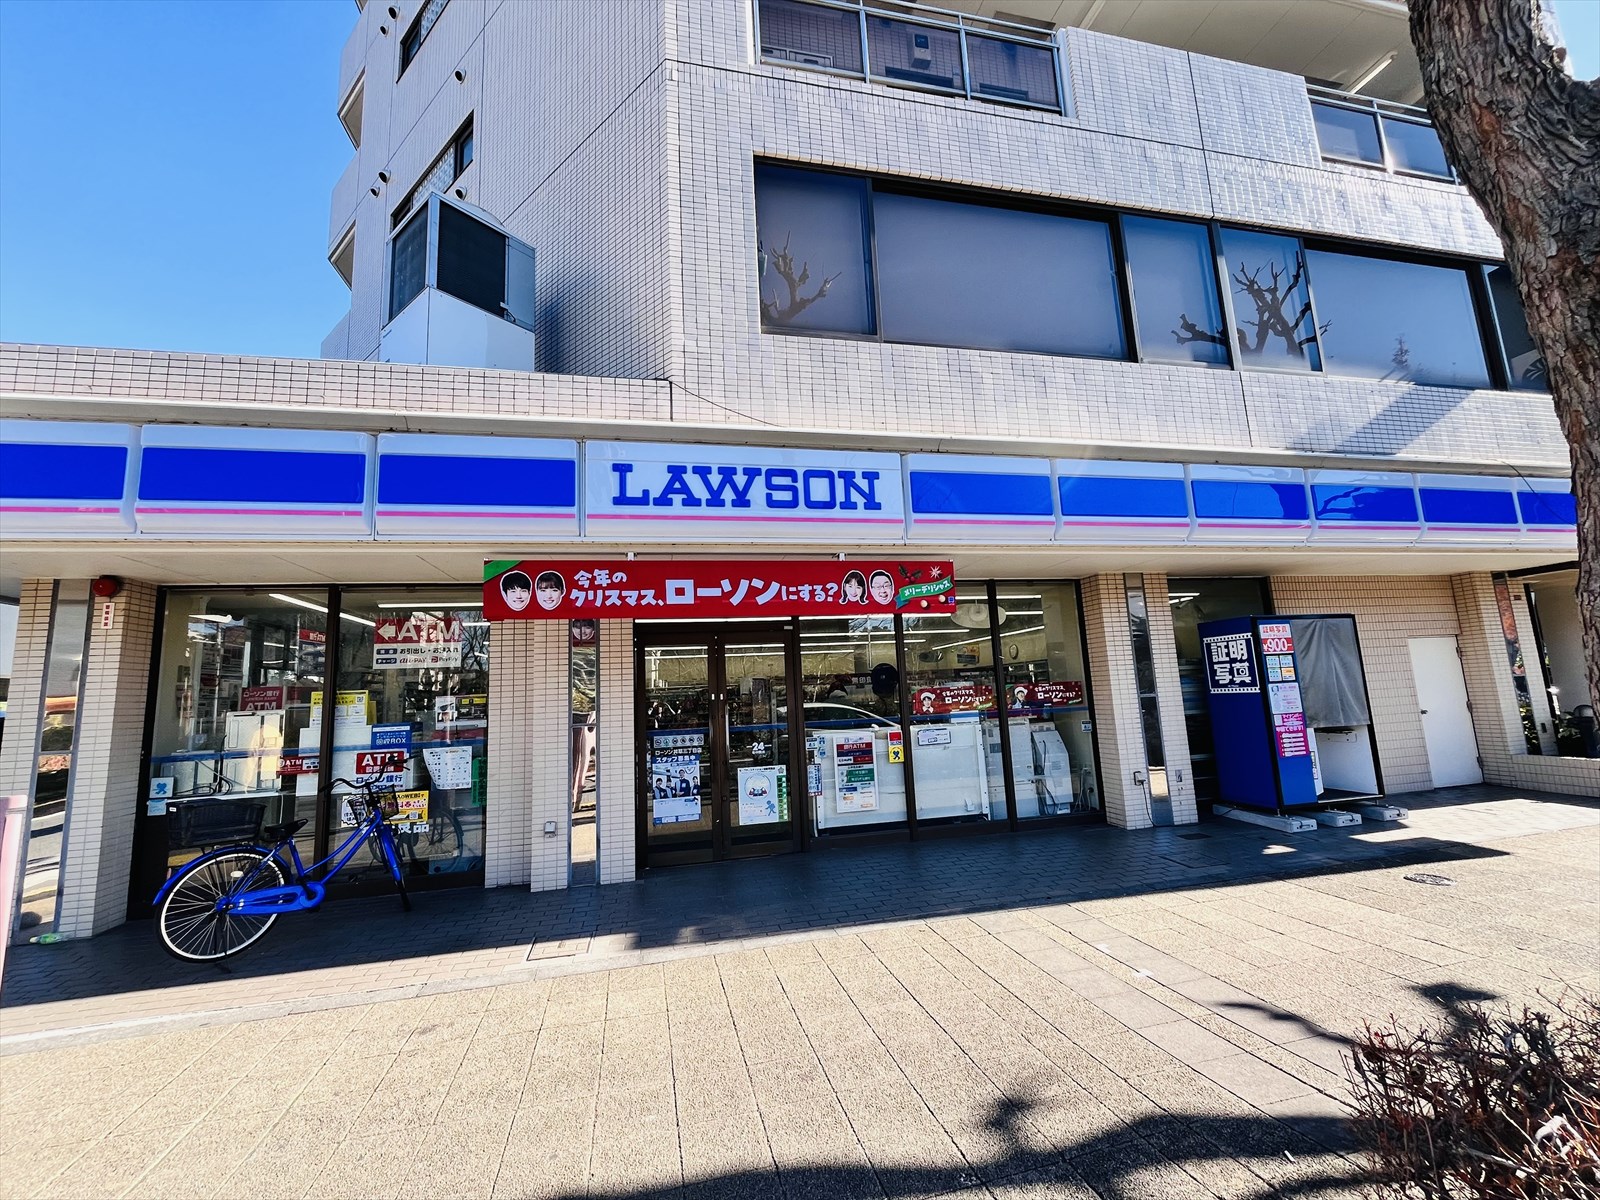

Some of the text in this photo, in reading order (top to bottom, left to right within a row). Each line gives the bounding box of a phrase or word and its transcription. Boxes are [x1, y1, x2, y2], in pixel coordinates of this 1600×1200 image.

[612, 463, 882, 510] LAWSON
[574, 569, 627, 588] 今年の
[904, 580, 950, 596] メリーデリシャス
[397, 620, 460, 640] ATM
[1210, 639, 1248, 662] 証明
[1213, 661, 1252, 684] 写真
[245, 701, 277, 711] ATM
[752, 742, 765, 751] 24
